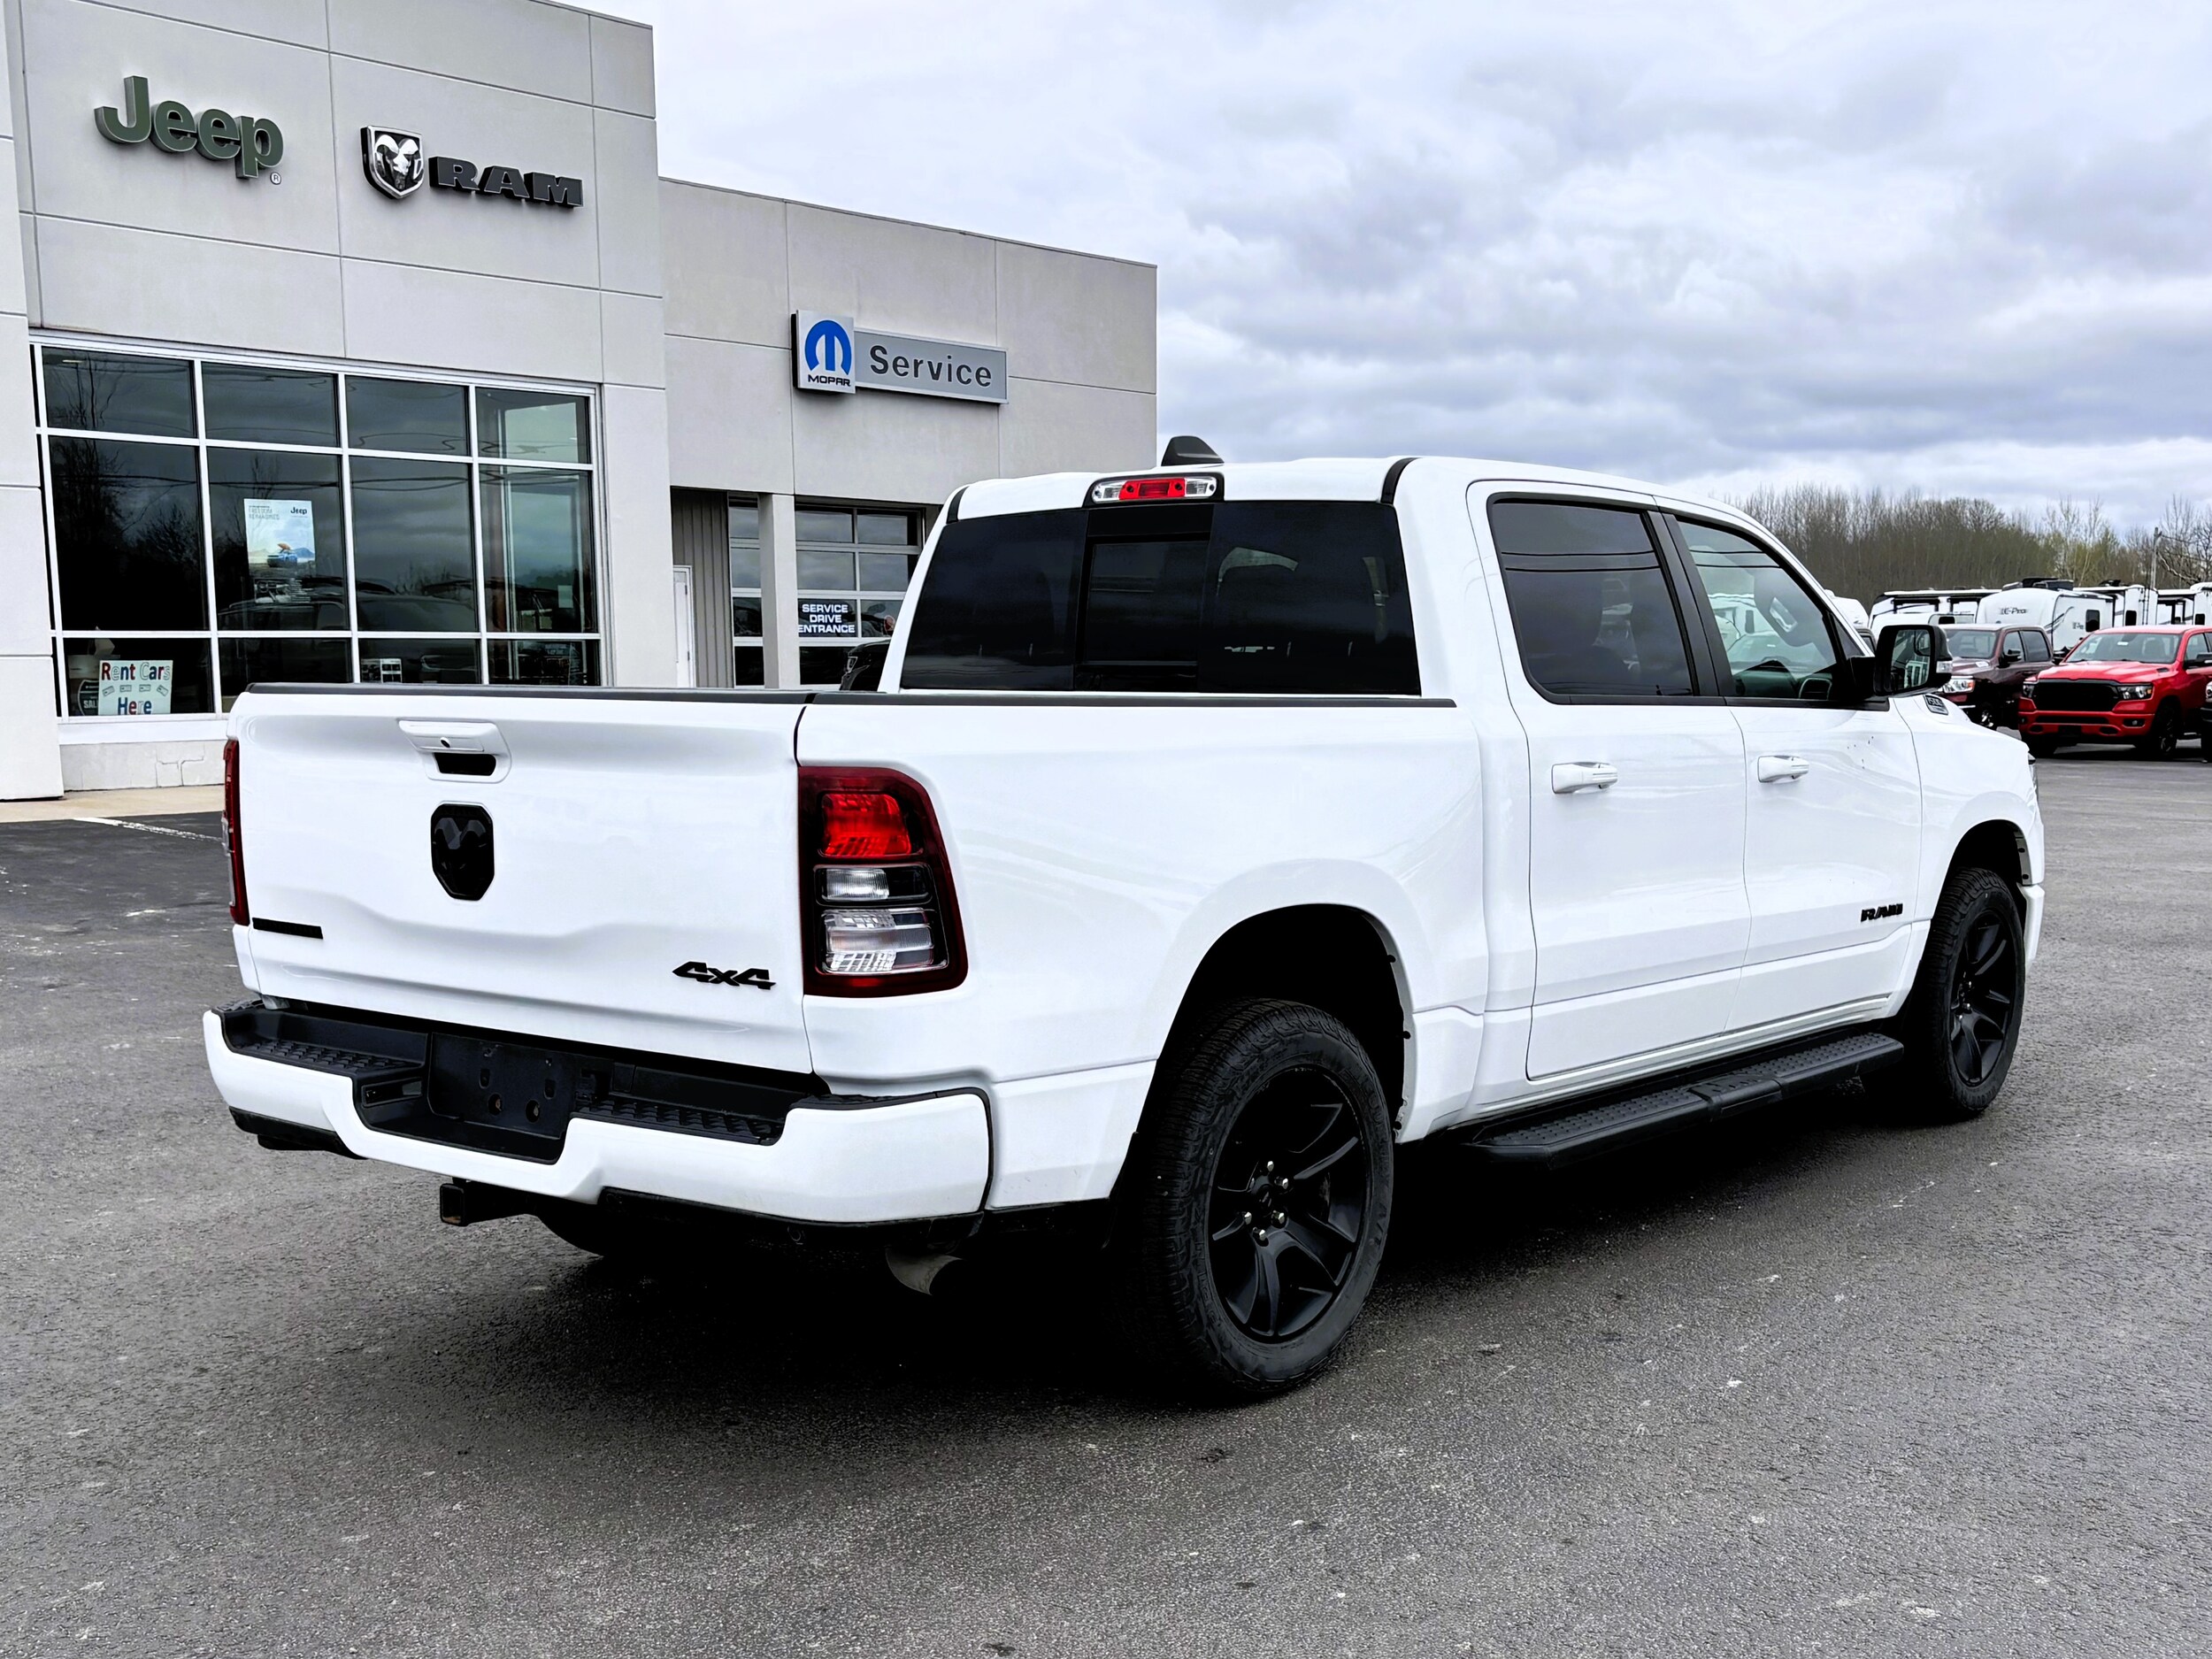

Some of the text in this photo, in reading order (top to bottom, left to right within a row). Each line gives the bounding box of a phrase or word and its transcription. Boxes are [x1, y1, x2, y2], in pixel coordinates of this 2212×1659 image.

[95, 76, 283, 179] Jeep
[429, 156, 584, 208] RAM
[870, 345, 992, 388] Service
[808, 374, 851, 388] MOPAR
[802, 603, 848, 613] SERVICE
[101, 662, 171, 681] Rent Cars
[83, 700, 98, 709] SAL
[118, 697, 152, 715] Here
[1861, 902, 1903, 923] RAM
